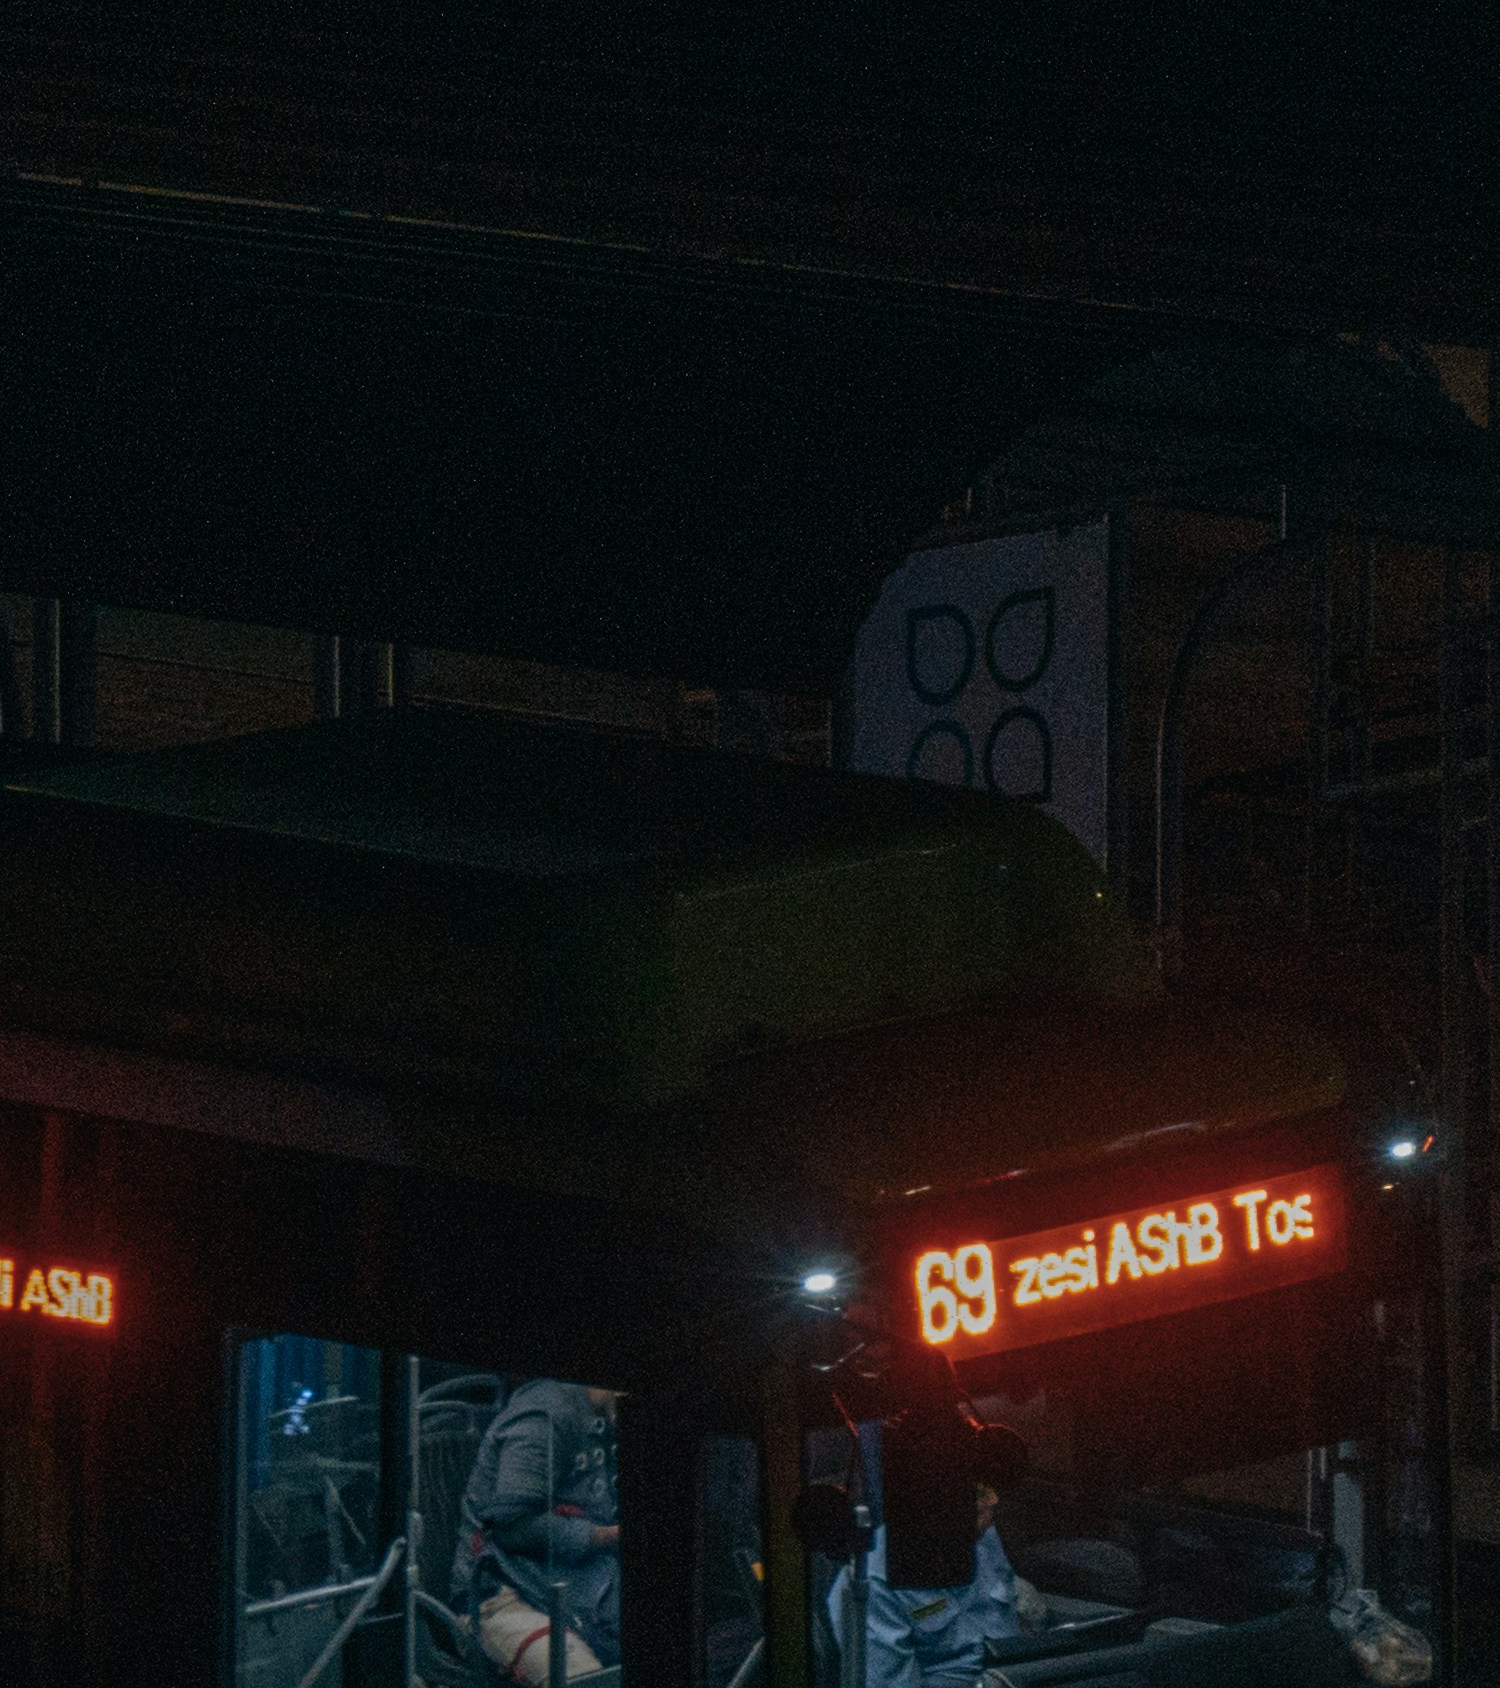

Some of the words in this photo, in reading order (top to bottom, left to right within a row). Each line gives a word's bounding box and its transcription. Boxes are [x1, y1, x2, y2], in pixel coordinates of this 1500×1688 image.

[915, 1241, 998, 1345] 69
[1009, 1229, 1099, 1307] zesi
[1105, 1201, 1223, 1285] AShB
